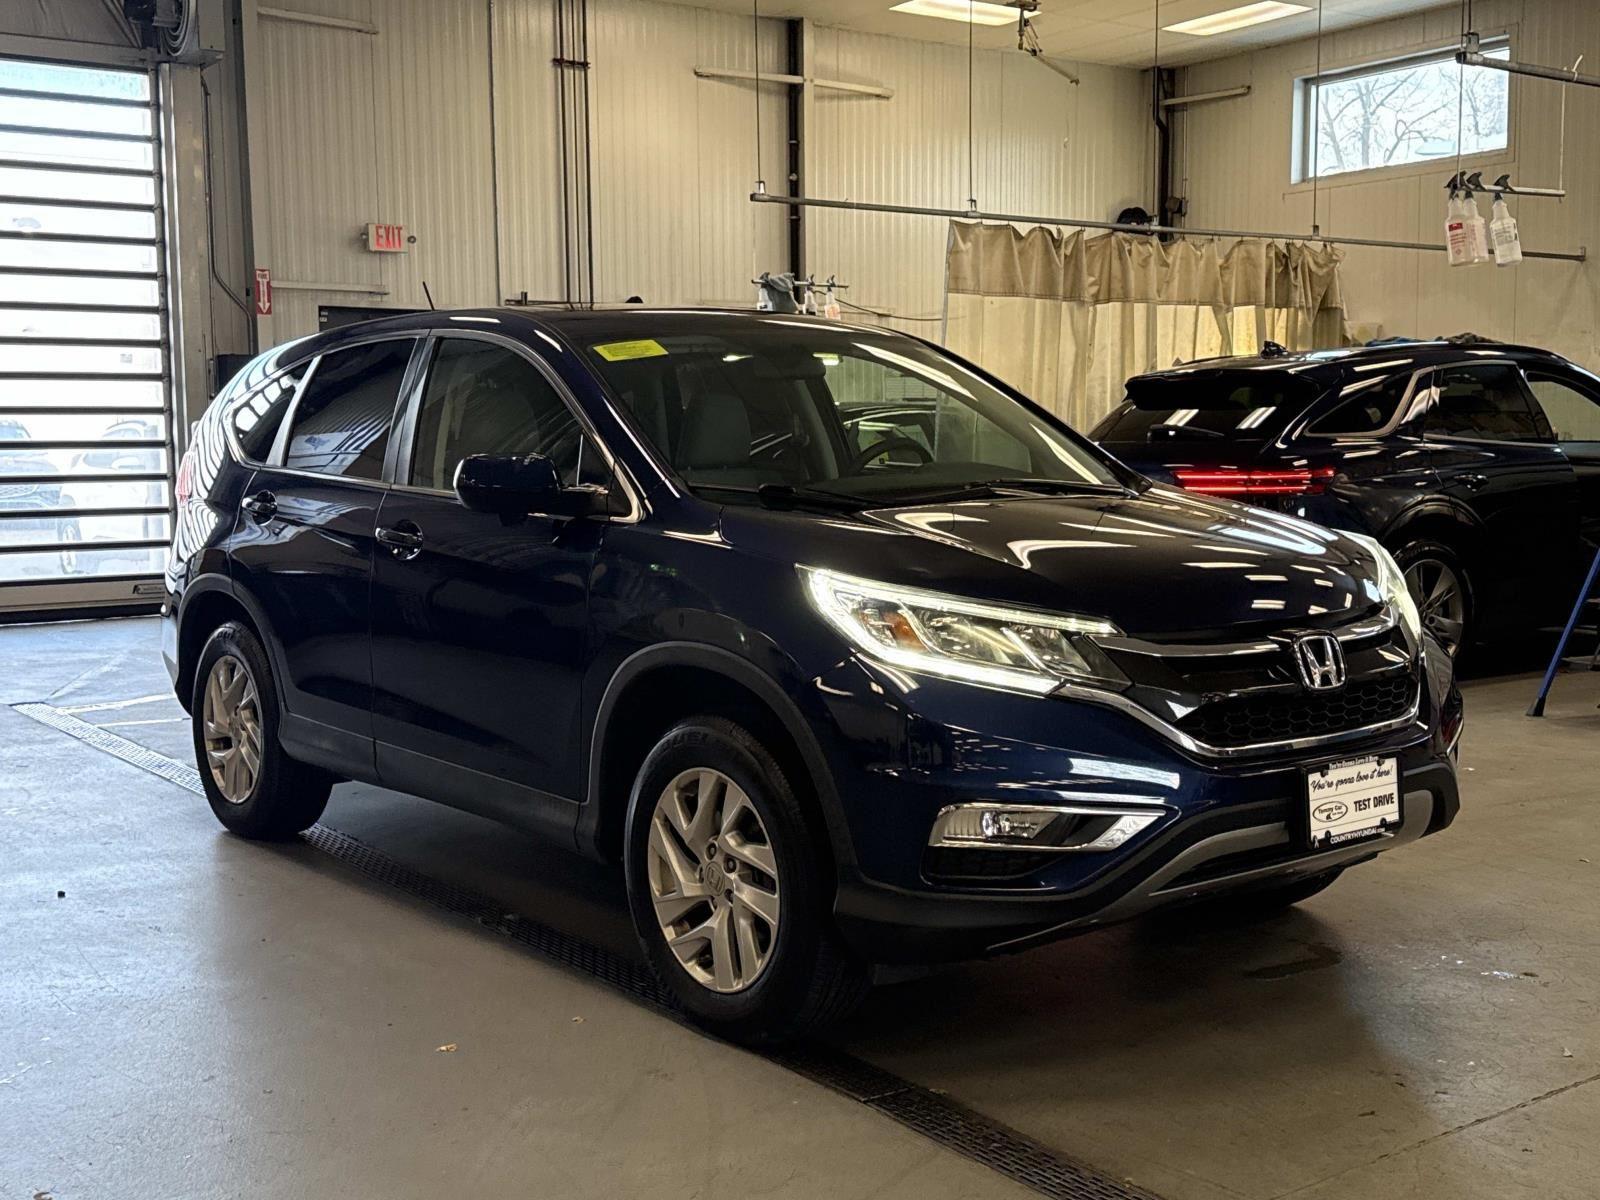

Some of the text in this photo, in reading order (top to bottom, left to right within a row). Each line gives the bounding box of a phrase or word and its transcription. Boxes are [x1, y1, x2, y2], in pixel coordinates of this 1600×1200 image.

[375, 225, 403, 248] EXIT
[1335, 776, 1355, 791] gonna
[1356, 771, 1369, 783] love
[1353, 792, 1395, 813] TEST DRIVE
